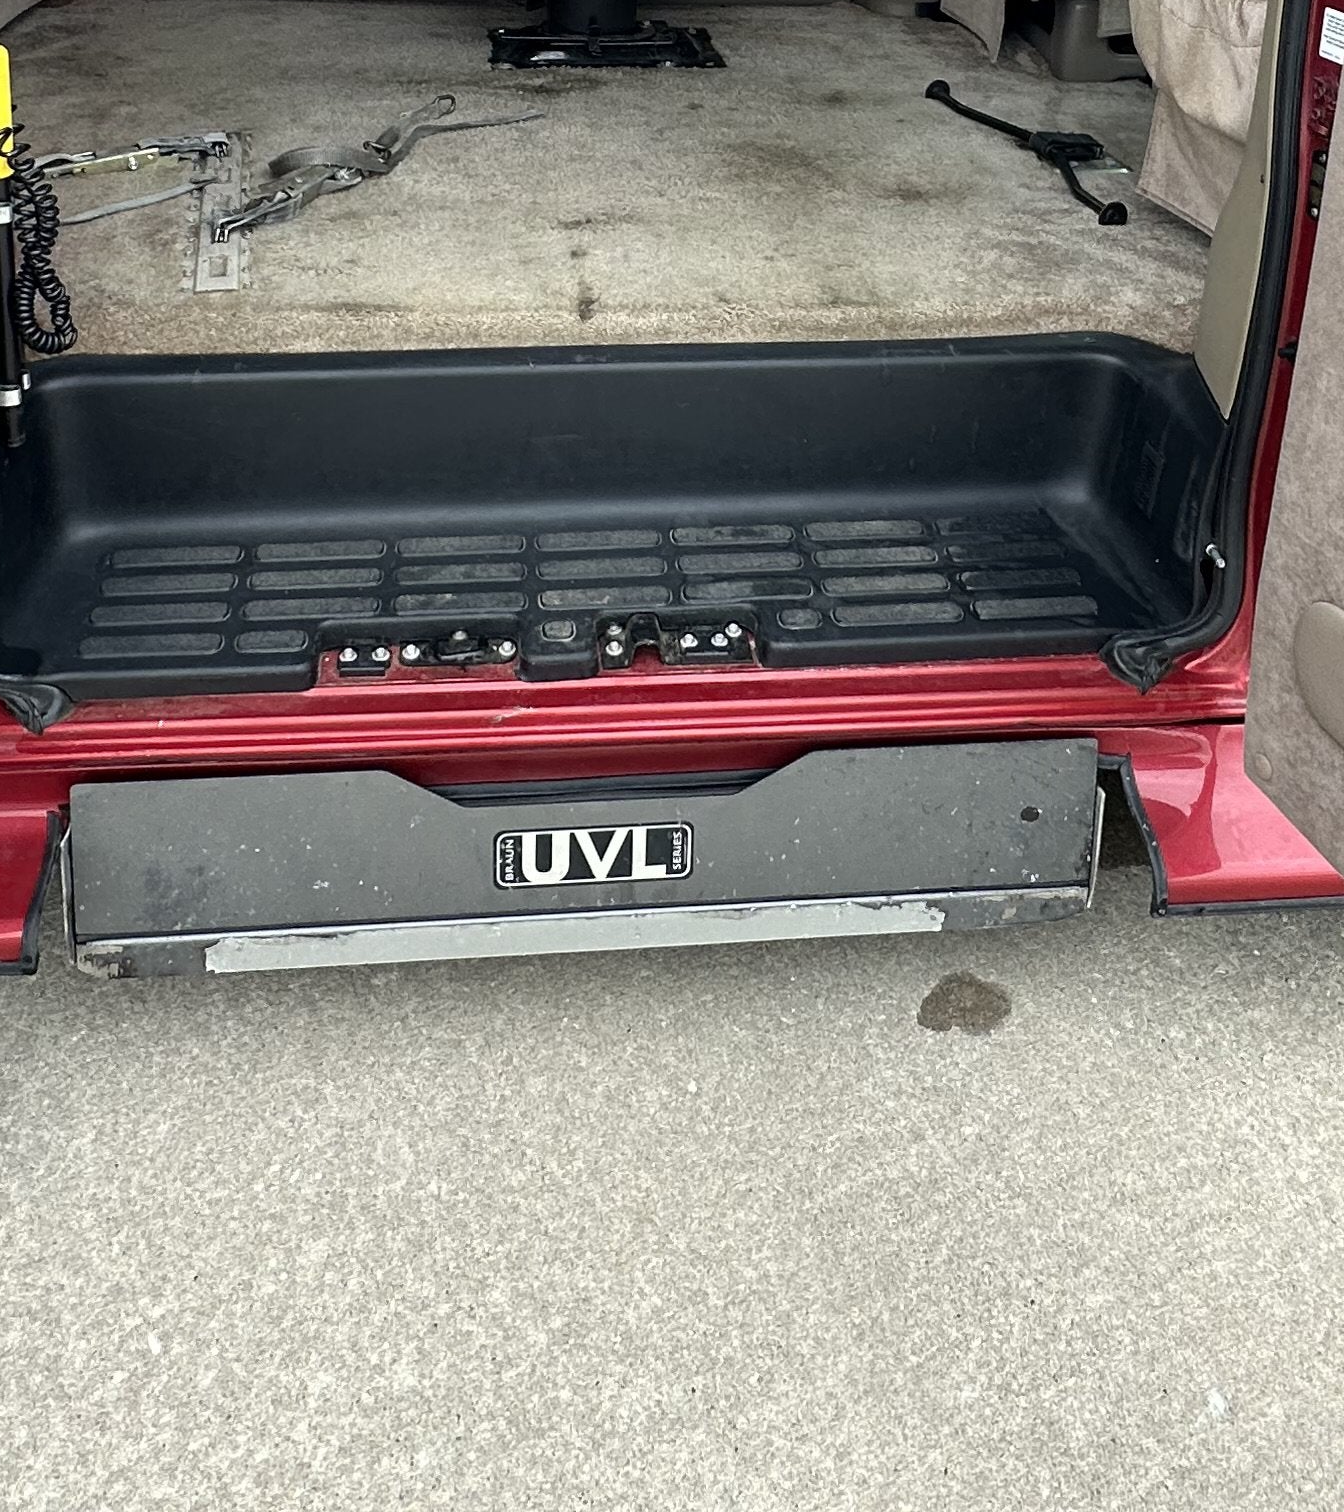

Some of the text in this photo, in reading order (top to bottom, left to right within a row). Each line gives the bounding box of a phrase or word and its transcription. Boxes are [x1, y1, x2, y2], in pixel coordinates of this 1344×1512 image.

[505, 839, 515, 881] BRAUN
[522, 828, 667, 883] UVL
[672, 830, 683, 870] SERIES
